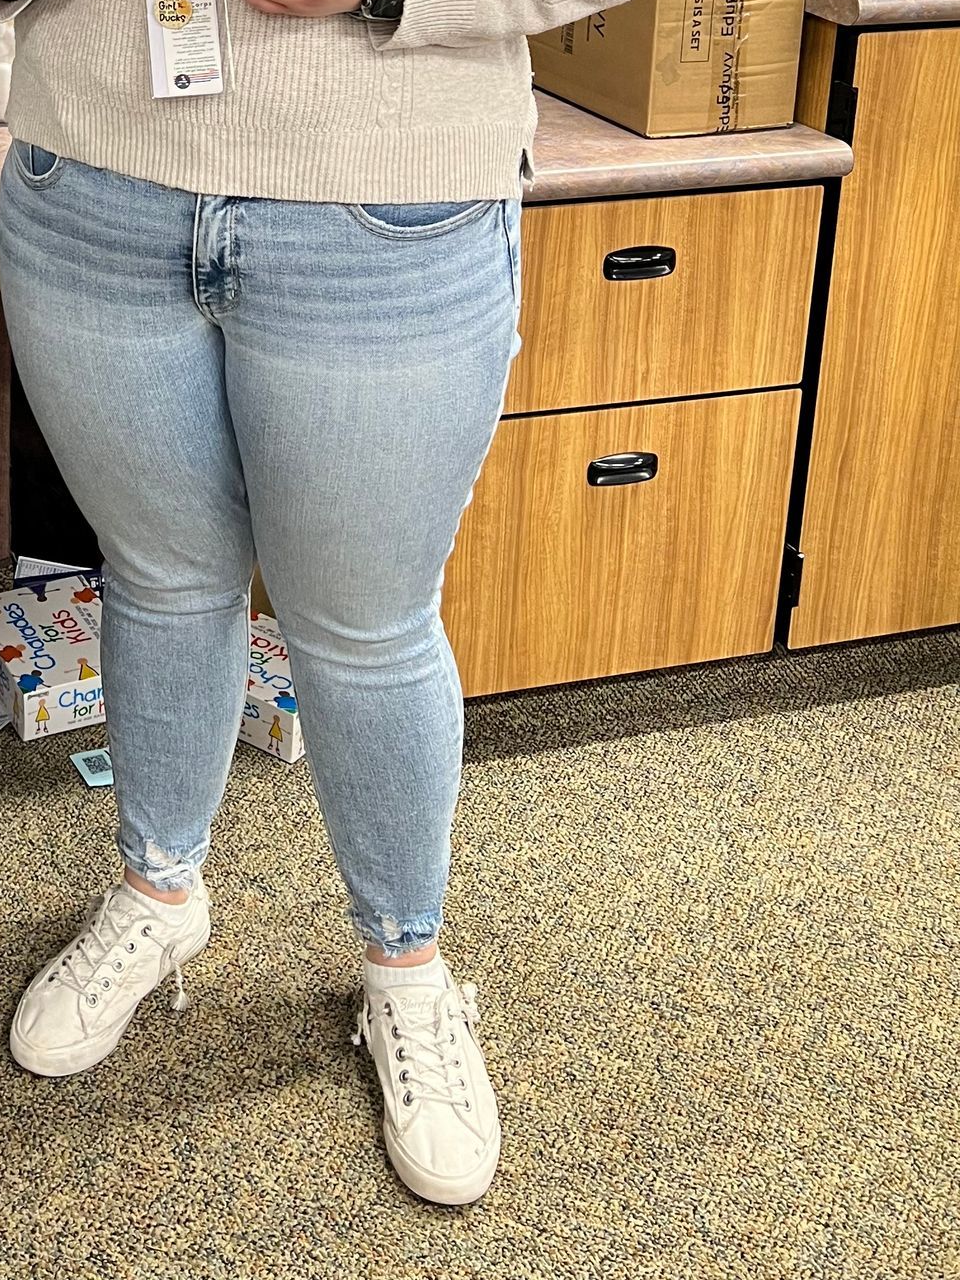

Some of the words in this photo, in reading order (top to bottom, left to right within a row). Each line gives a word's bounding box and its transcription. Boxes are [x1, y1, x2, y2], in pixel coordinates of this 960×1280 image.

[158, 0, 177, 11] Girl
[693, 6, 703, 17] IS
[159, 13, 186, 23] Ducks
[692, 19, 701, 28] A
[690, 30, 701, 51] SET
[3, 602, 56, 670] Charades
[38, 624, 64, 643] for
[52, 609, 92, 645] Kids
[250, 633, 289, 661] Kid
[250, 650, 273, 665] fo
[249, 662, 292, 690] Cha
[58, 687, 104, 708] Char
[72, 704, 96, 719] for
